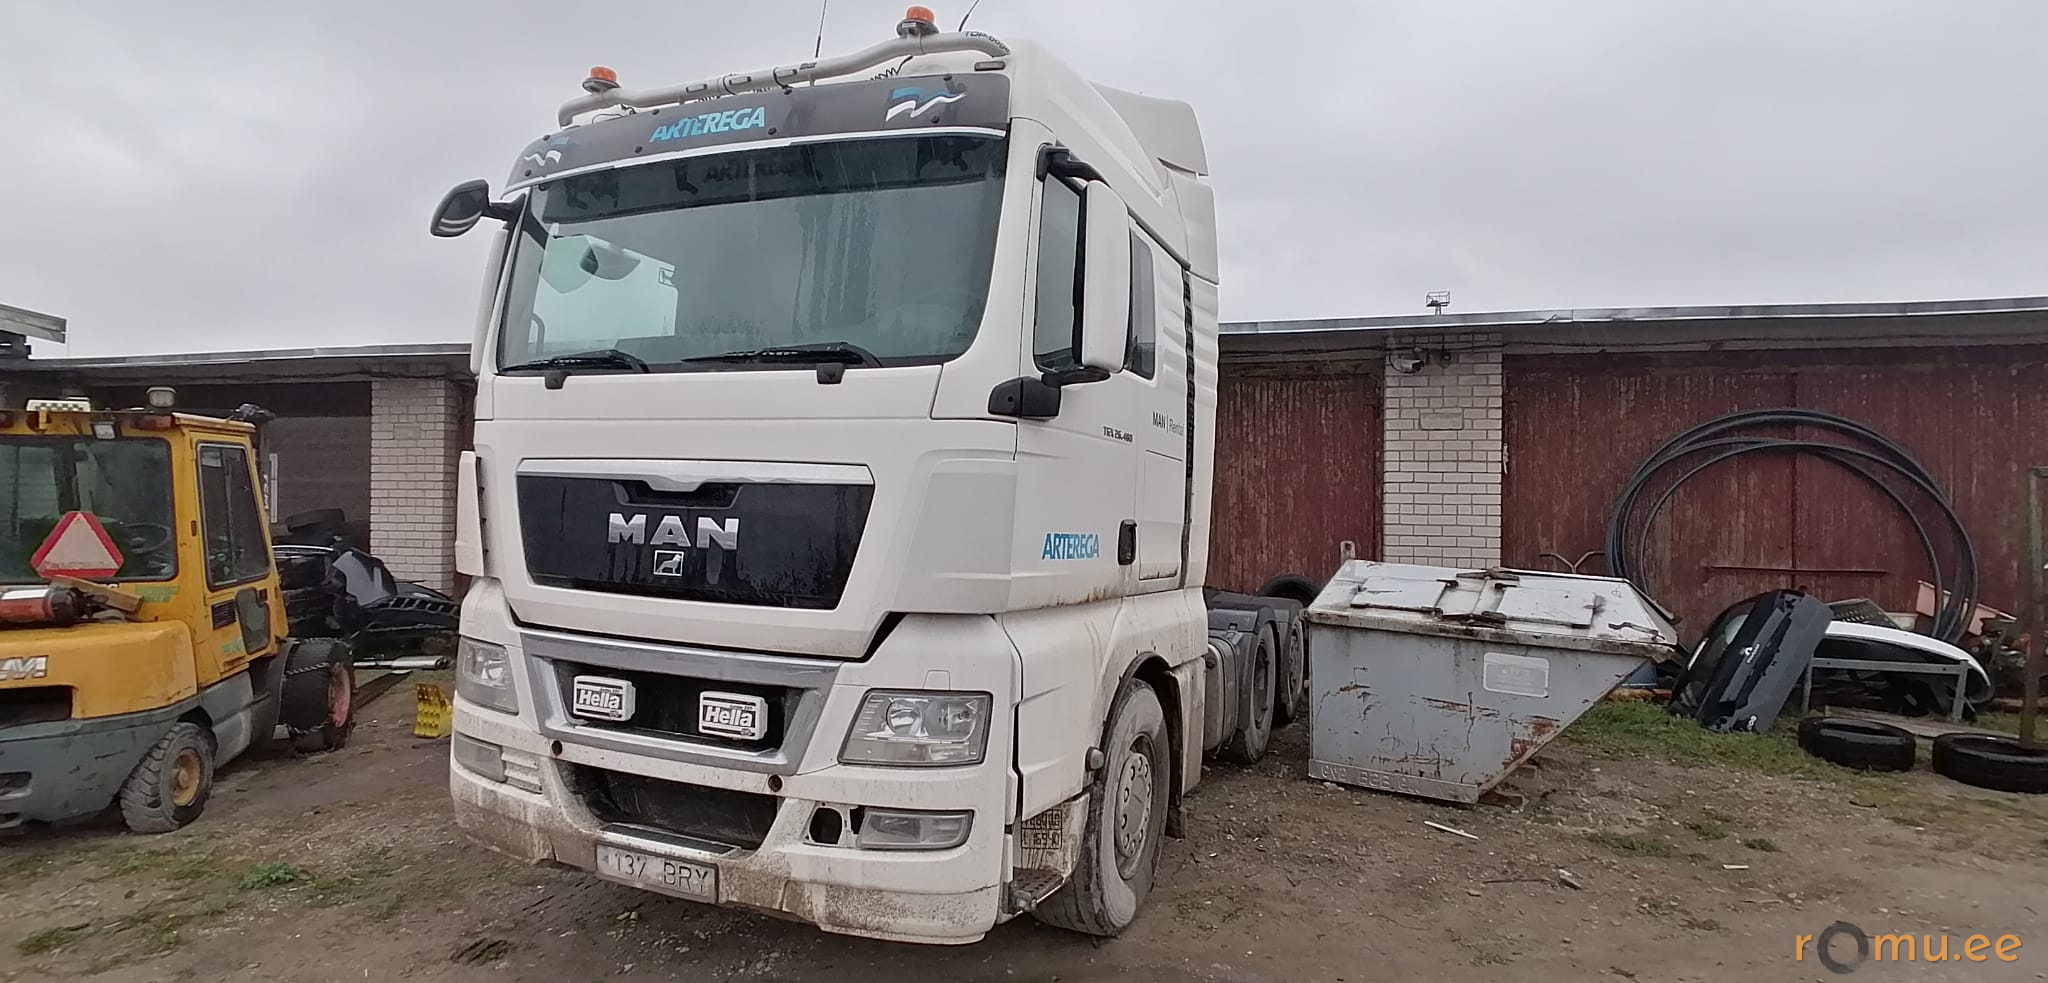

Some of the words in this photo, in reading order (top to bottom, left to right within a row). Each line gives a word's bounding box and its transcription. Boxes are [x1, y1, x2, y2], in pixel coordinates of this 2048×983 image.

[649, 106, 765, 143] ARTEREGA
[1152, 411, 1166, 429] MAN
[607, 512, 740, 551] MAN
[1041, 532, 1100, 560] ARTEREGA
[578, 689, 621, 710] Hella
[705, 706, 753, 728] Hella
[615, 853, 648, 879] 137
[663, 860, 709, 893] BRY
